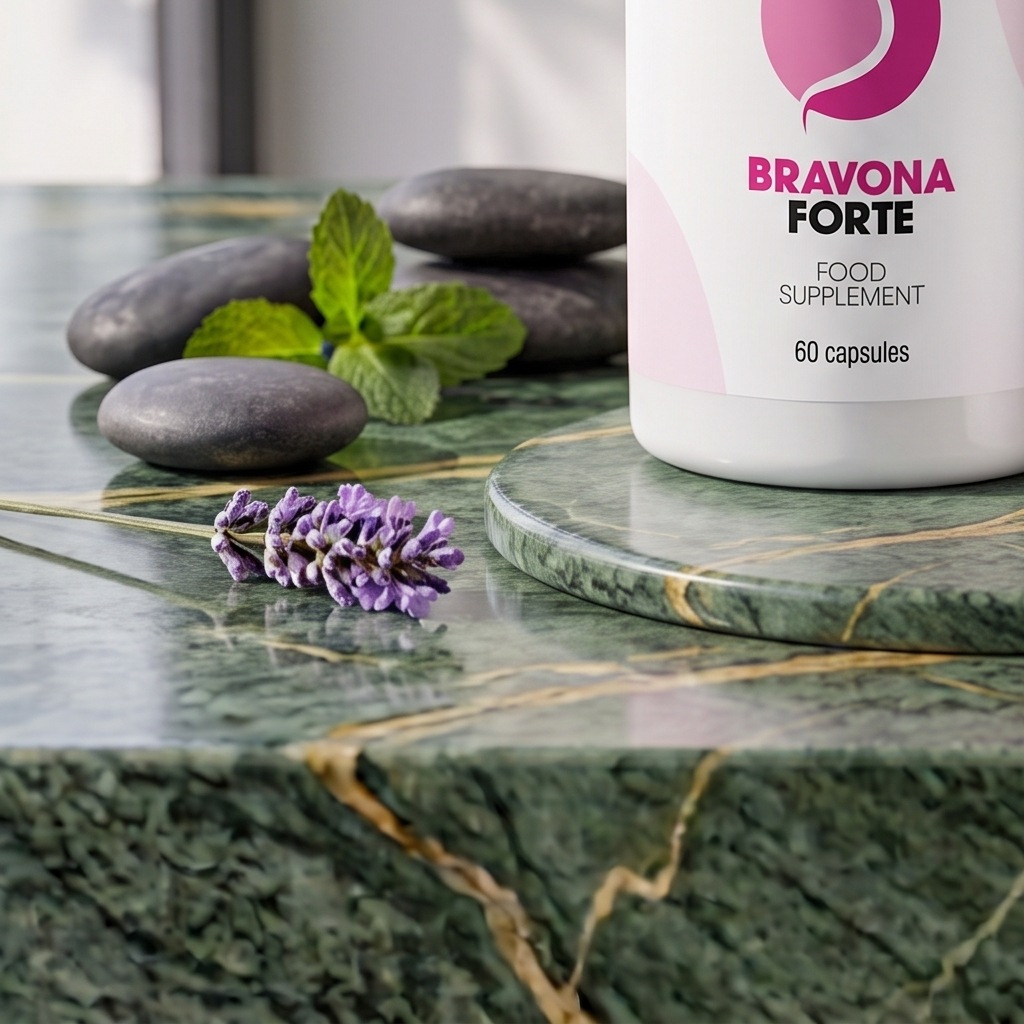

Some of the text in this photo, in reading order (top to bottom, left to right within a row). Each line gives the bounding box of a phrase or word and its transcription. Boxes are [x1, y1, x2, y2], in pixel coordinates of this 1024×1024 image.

[748, 155, 956, 196] BRAVONA
[788, 199, 914, 235] FORTE
[816, 261, 887, 282] FOOD
[779, 284, 925, 307] SUPPLEMENT
[794, 340, 910, 369] 60 capsules
